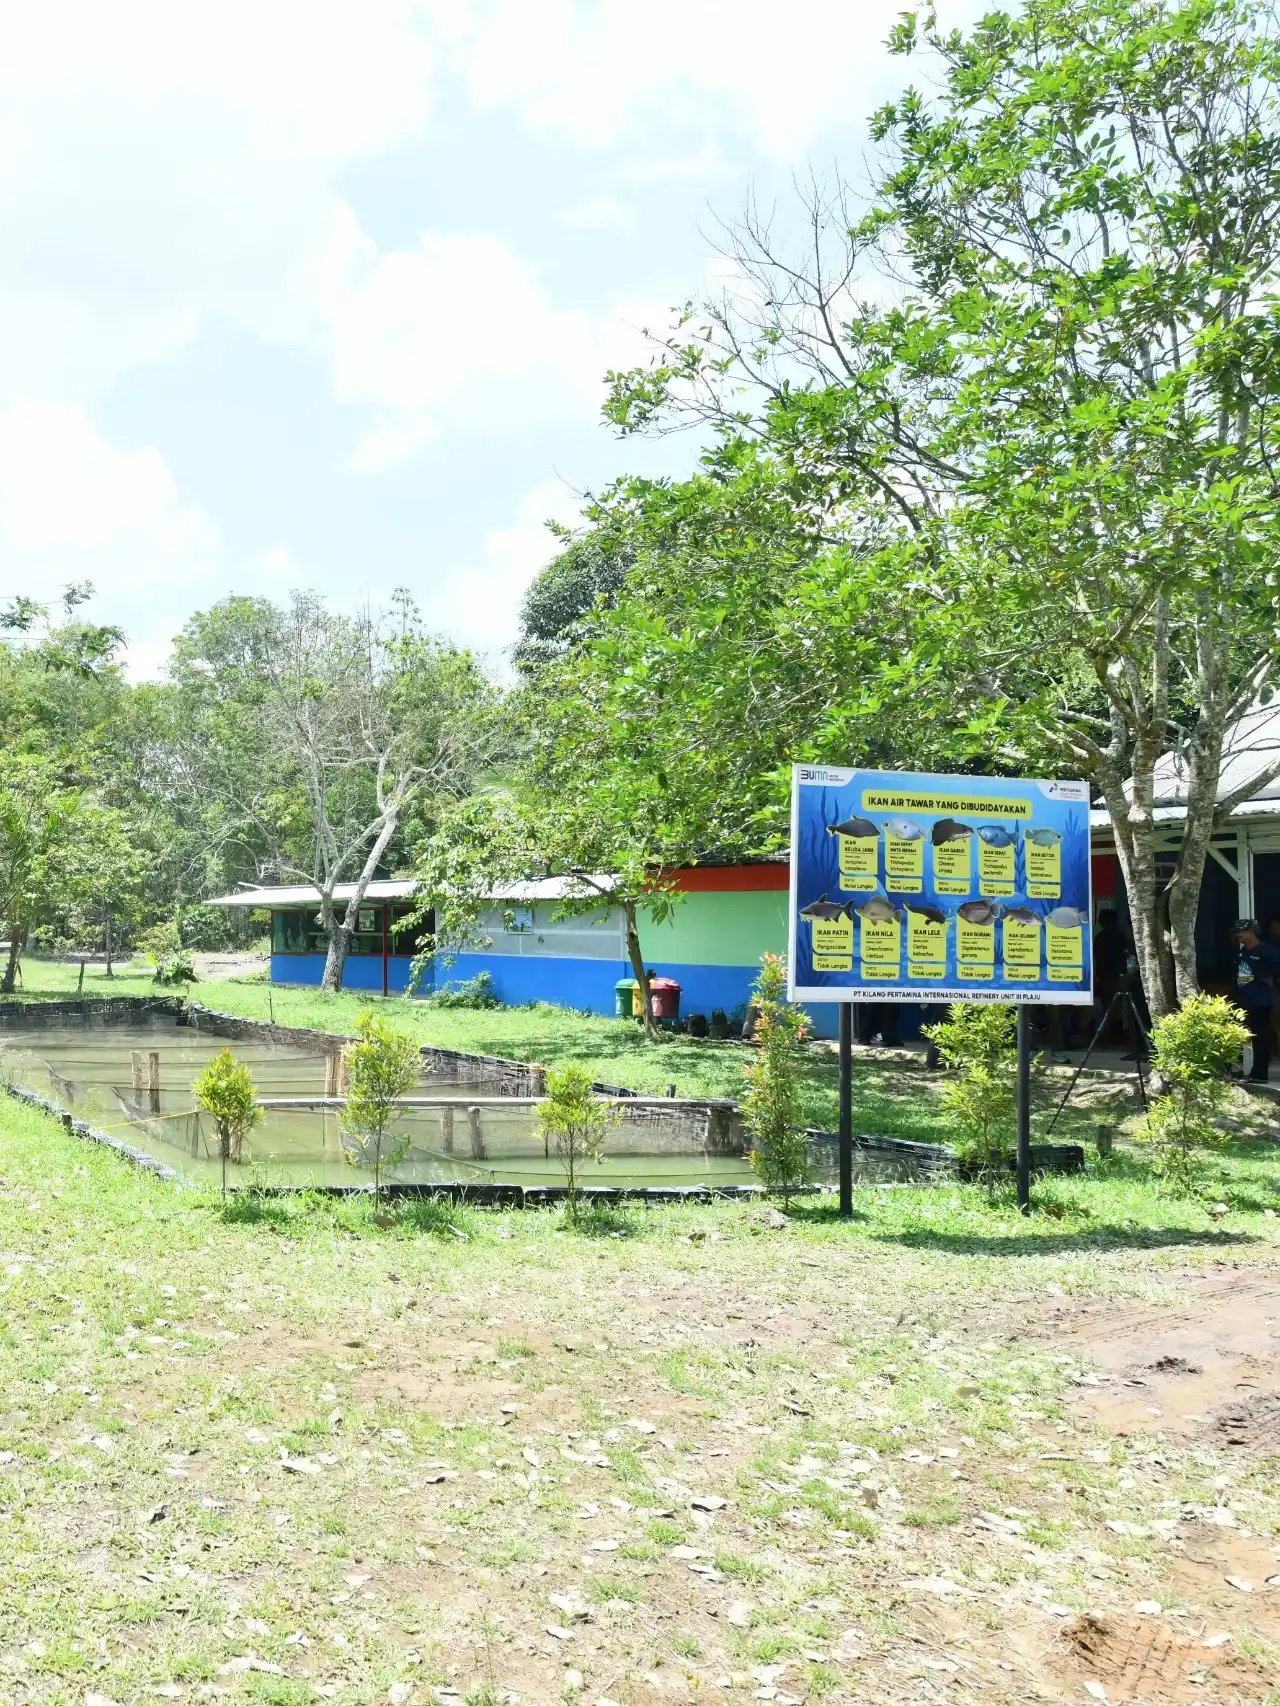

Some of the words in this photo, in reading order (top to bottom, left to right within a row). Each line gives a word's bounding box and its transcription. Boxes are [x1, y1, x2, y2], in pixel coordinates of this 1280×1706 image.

[868, 796, 888, 806] IKAN
[891, 798, 904, 806] AIR
[906, 798, 934, 808] TAWAR
[935, 801, 959, 810] YANG
[961, 802, 1026, 813] DIBUDIDAYAKAN
